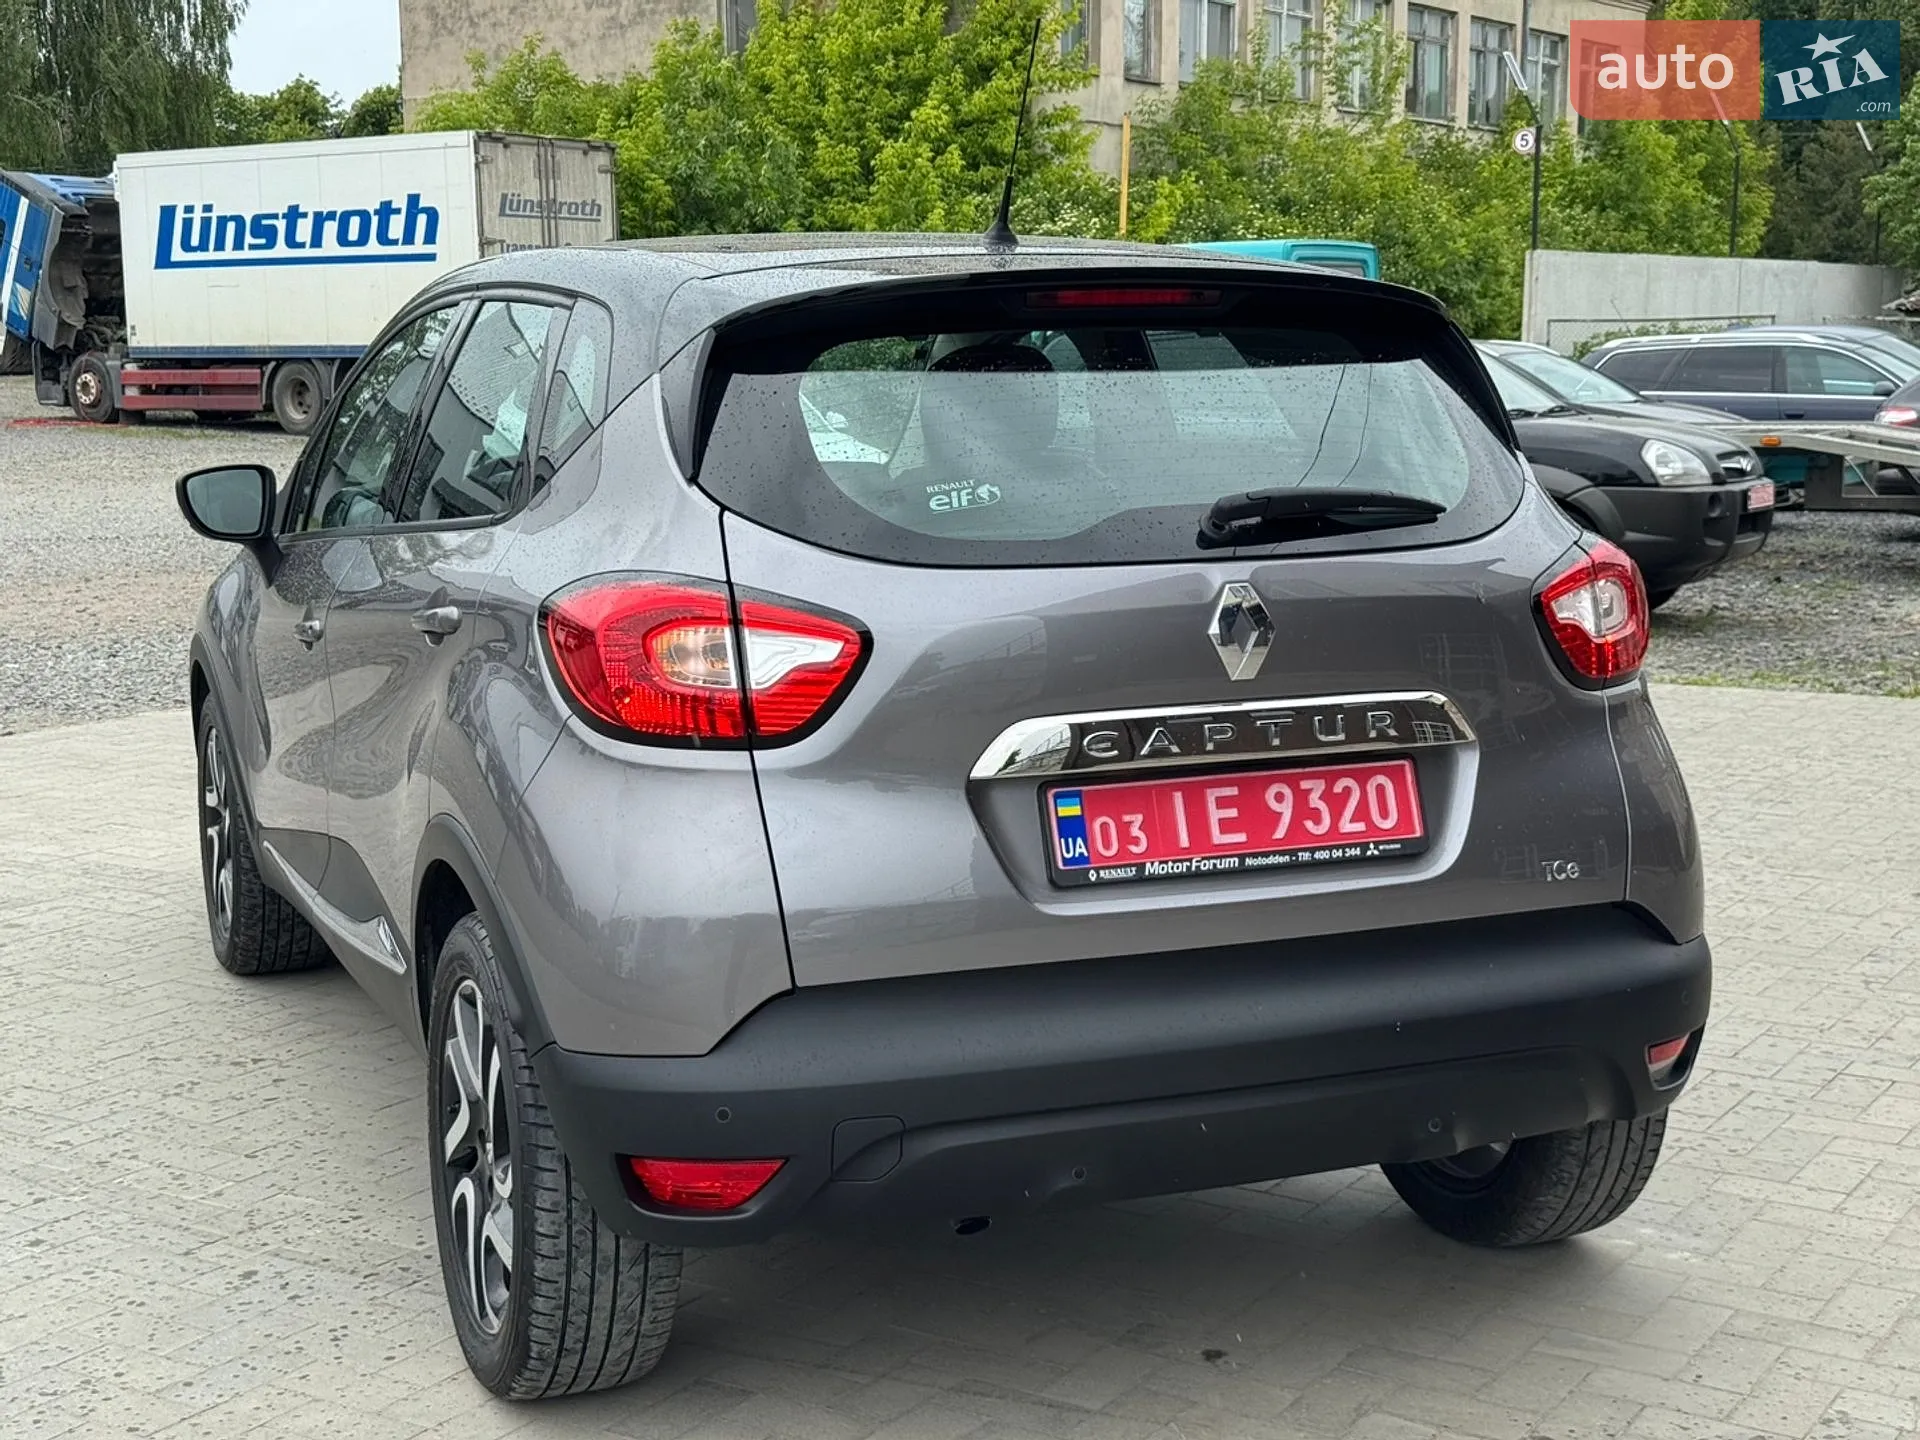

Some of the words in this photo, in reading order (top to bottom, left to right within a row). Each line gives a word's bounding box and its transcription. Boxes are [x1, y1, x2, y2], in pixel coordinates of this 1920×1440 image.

[1520, 133, 1529, 148] 5
[154, 193, 440, 270] Lünstroth
[926, 479, 976, 493] RENAULT
[929, 488, 973, 511] elf
[1083, 710, 1399, 757] CAPTUR
[1092, 813, 1148, 857] 03
[1060, 837, 1089, 858] UA
[1245, 854, 1290, 866] Notodden
[1313, 850, 1330, 860] 400
[1331, 849, 1343, 859] 04
[1541, 860, 1580, 882] TCe
